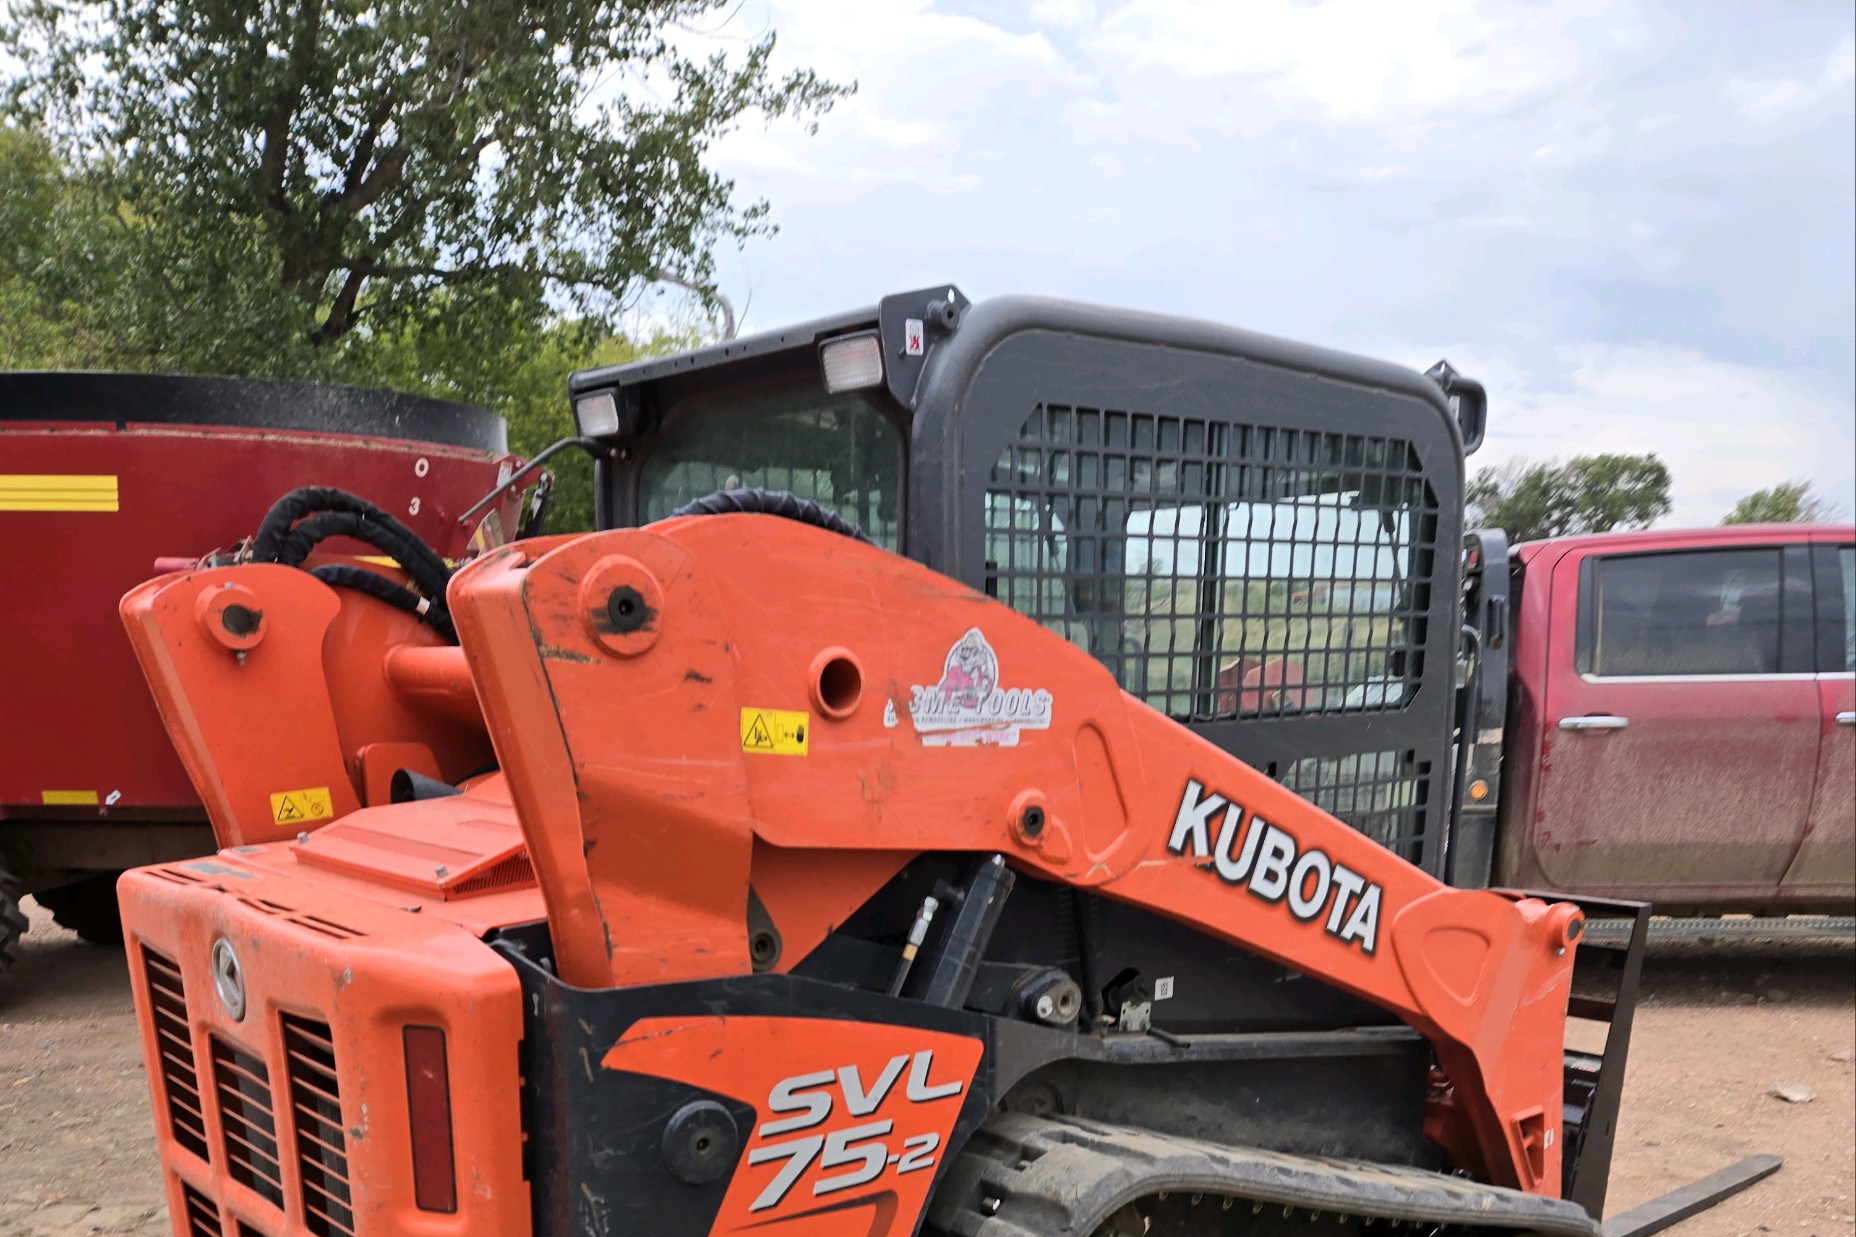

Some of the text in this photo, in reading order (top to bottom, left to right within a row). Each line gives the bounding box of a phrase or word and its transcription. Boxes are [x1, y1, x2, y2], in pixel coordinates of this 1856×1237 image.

[408, 496, 421, 516] 3
[888, 687, 1048, 716] ME TOOLS
[1167, 777, 1382, 953] KUBOTA
[758, 1049, 963, 1138] SVL
[747, 1118, 941, 1213] 75-2
